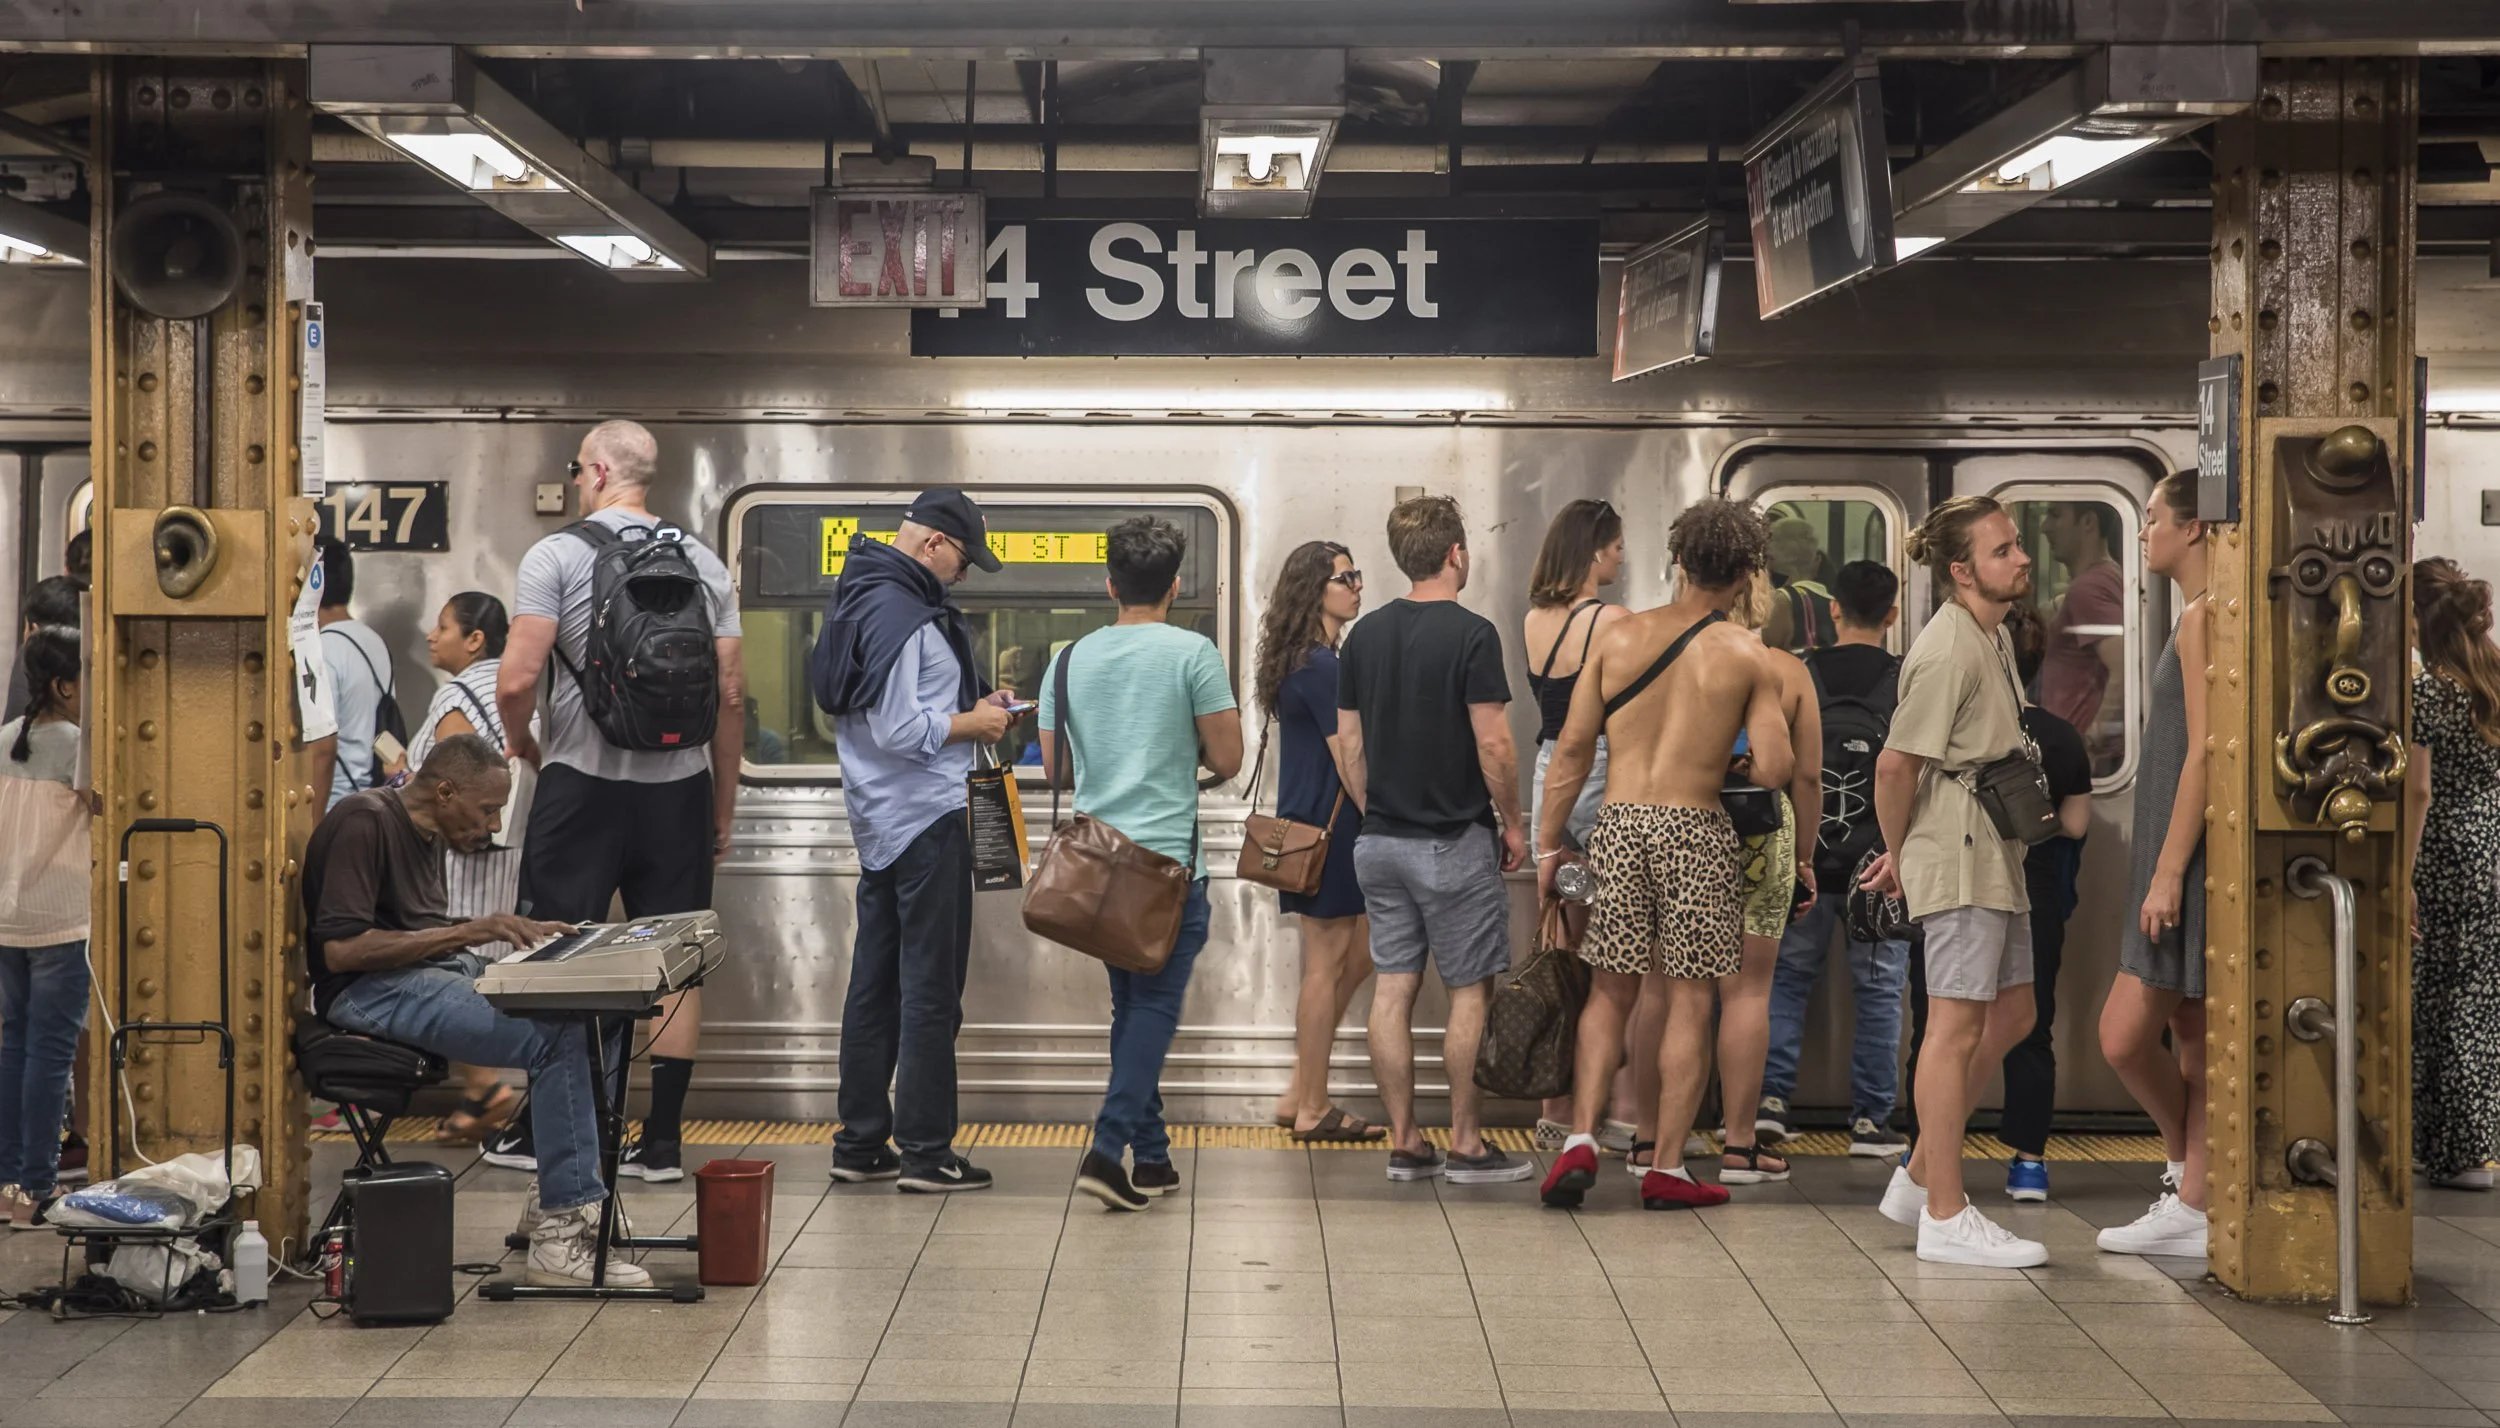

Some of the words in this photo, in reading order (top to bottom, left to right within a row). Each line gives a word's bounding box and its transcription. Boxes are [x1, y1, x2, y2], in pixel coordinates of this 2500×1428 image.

[1801, 114, 1839, 174] mezzanine
[1772, 205, 1781, 249] at
[1781, 197, 1795, 244] end
[1802, 178, 1834, 242] platform
[839, 200, 964, 296] EXIT
[939, 224, 1040, 318] 4
[1085, 222, 1438, 321] Street
[310, 328, 318, 344] E
[2199, 384, 2214, 436] 14
[2199, 440, 2226, 477] Street
[314, 487, 427, 543] 147
[1033, 535, 1070, 559] ST
[312, 569, 320, 584] A
